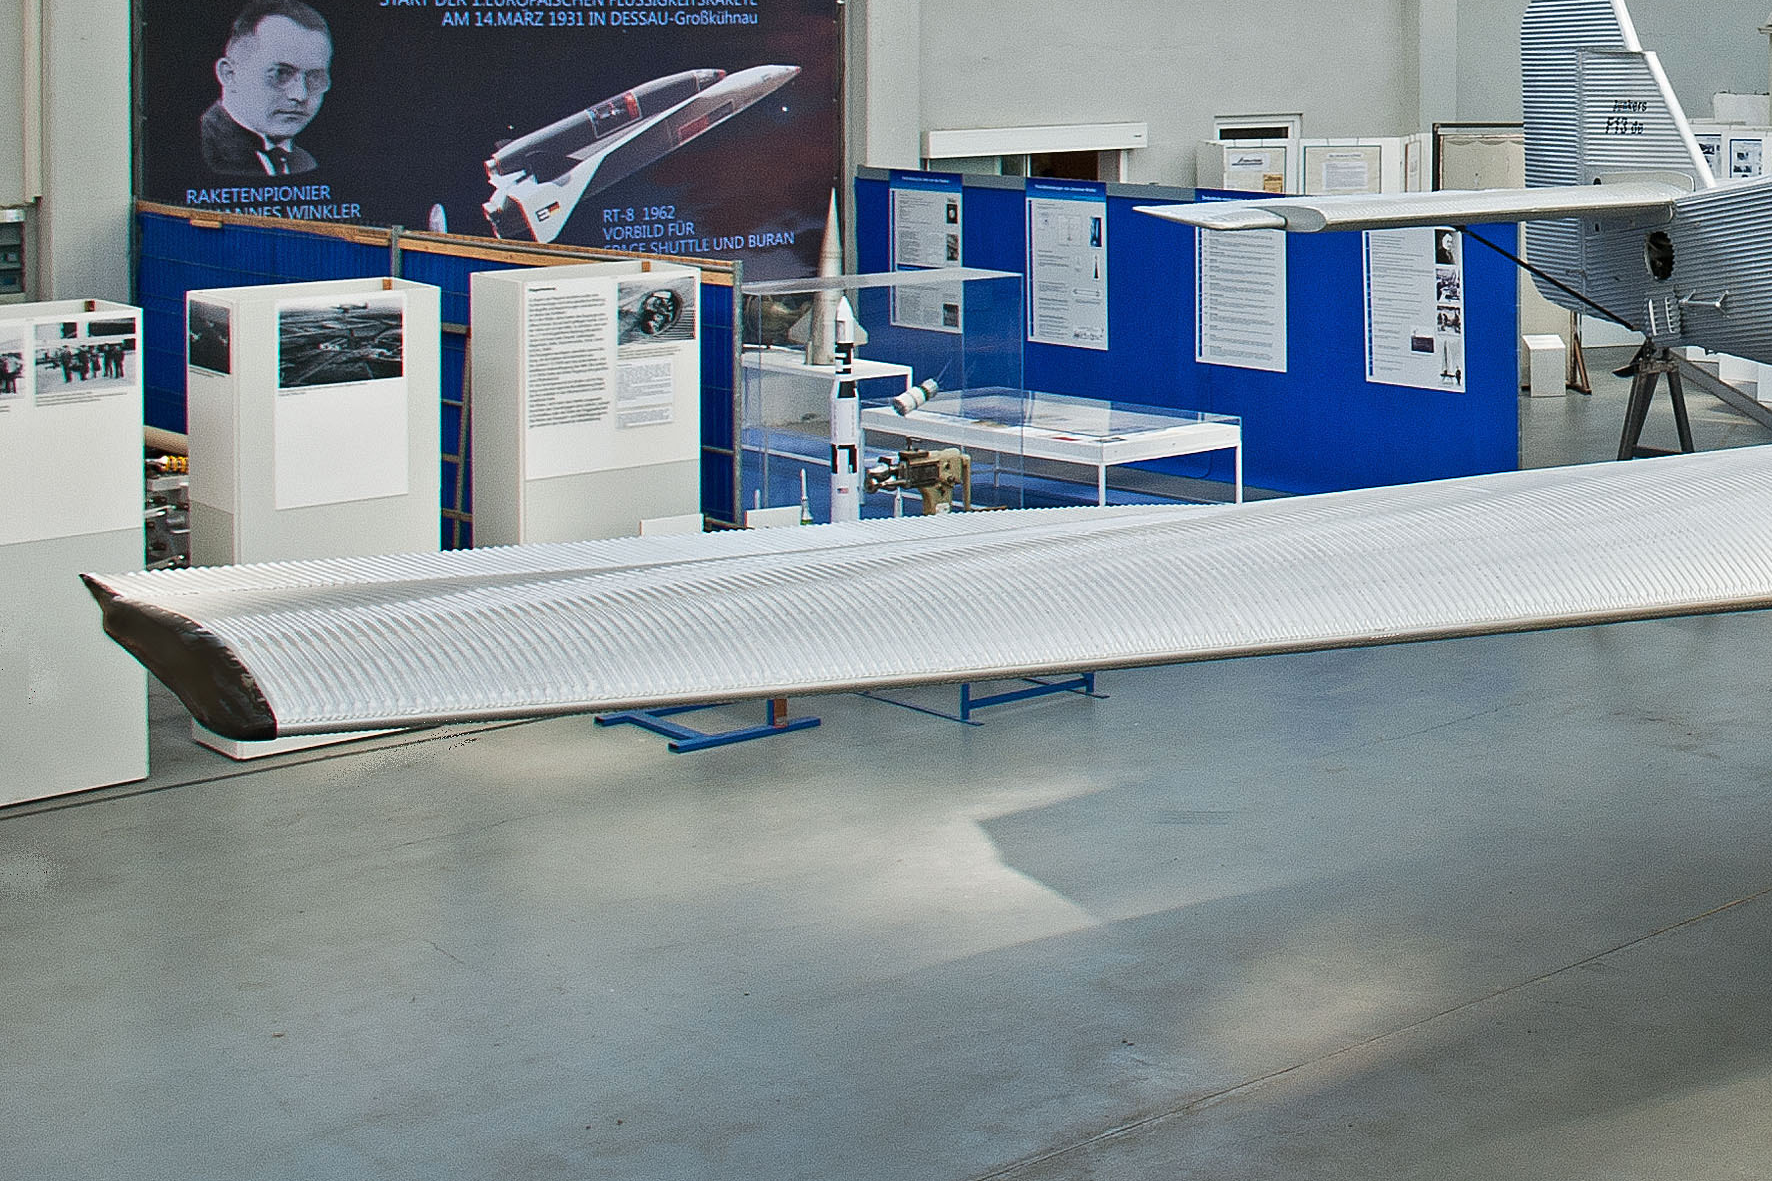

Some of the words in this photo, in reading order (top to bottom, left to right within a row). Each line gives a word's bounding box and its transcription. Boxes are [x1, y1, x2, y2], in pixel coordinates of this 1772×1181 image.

[441, 11, 469, 26] AM
[549, 10, 583, 27] 1931
[588, 10, 605, 27] IN
[611, 10, 758, 27] DESSAU-Großkühnau
[186, 185, 331, 205] RAKETENPIONIER
[286, 203, 362, 220] WINKLER
[603, 208, 635, 223] RT-8
[642, 205, 675, 220] 1962
[603, 224, 664, 241] VORBILD
[668, 221, 695, 237] FÜR
[651, 239, 710, 255] SHUTTLE
[714, 235, 744, 251] UND
[749, 231, 795, 248] BURAN
